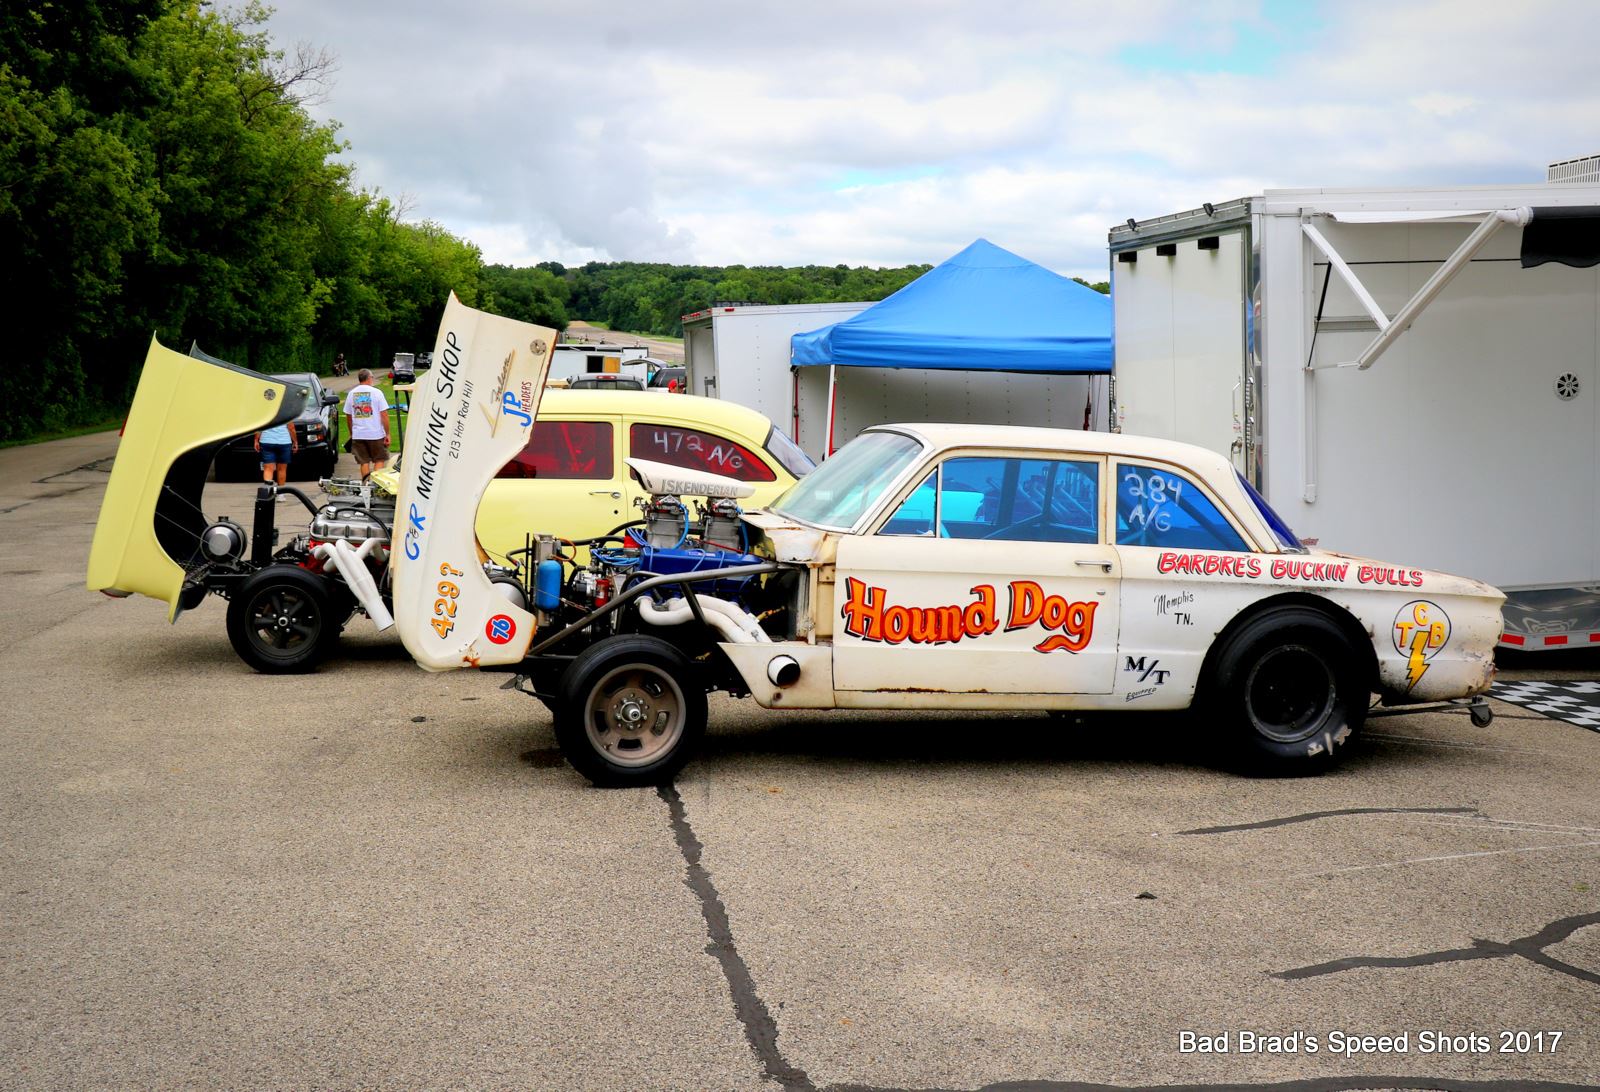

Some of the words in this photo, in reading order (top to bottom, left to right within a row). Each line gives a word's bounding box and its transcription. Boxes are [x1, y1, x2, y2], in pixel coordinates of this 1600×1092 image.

[464, 380, 474, 399] Hill
[521, 381, 532, 413] HEADERS
[416, 401, 448, 500] MACHINE
[437, 331, 462, 399] SHOP
[461, 398, 470, 419] Rod
[503, 391, 532, 427] JP
[456, 419, 465, 438] Hot
[449, 439, 461, 459] 213
[654, 431, 703, 453] 472
[660, 479, 738, 496] ISKENDERIAN
[1125, 473, 1182, 507] 284
[1357, 565, 1424, 587] BULLS
[1154, 590, 1194, 616] Memphis
[841, 576, 999, 645] Hound
[1004, 581, 1098, 654] Dog
[1174, 612, 1194, 626] TN.
[492, 618, 511, 639] 76
[1123, 655, 1171, 686] M/T
